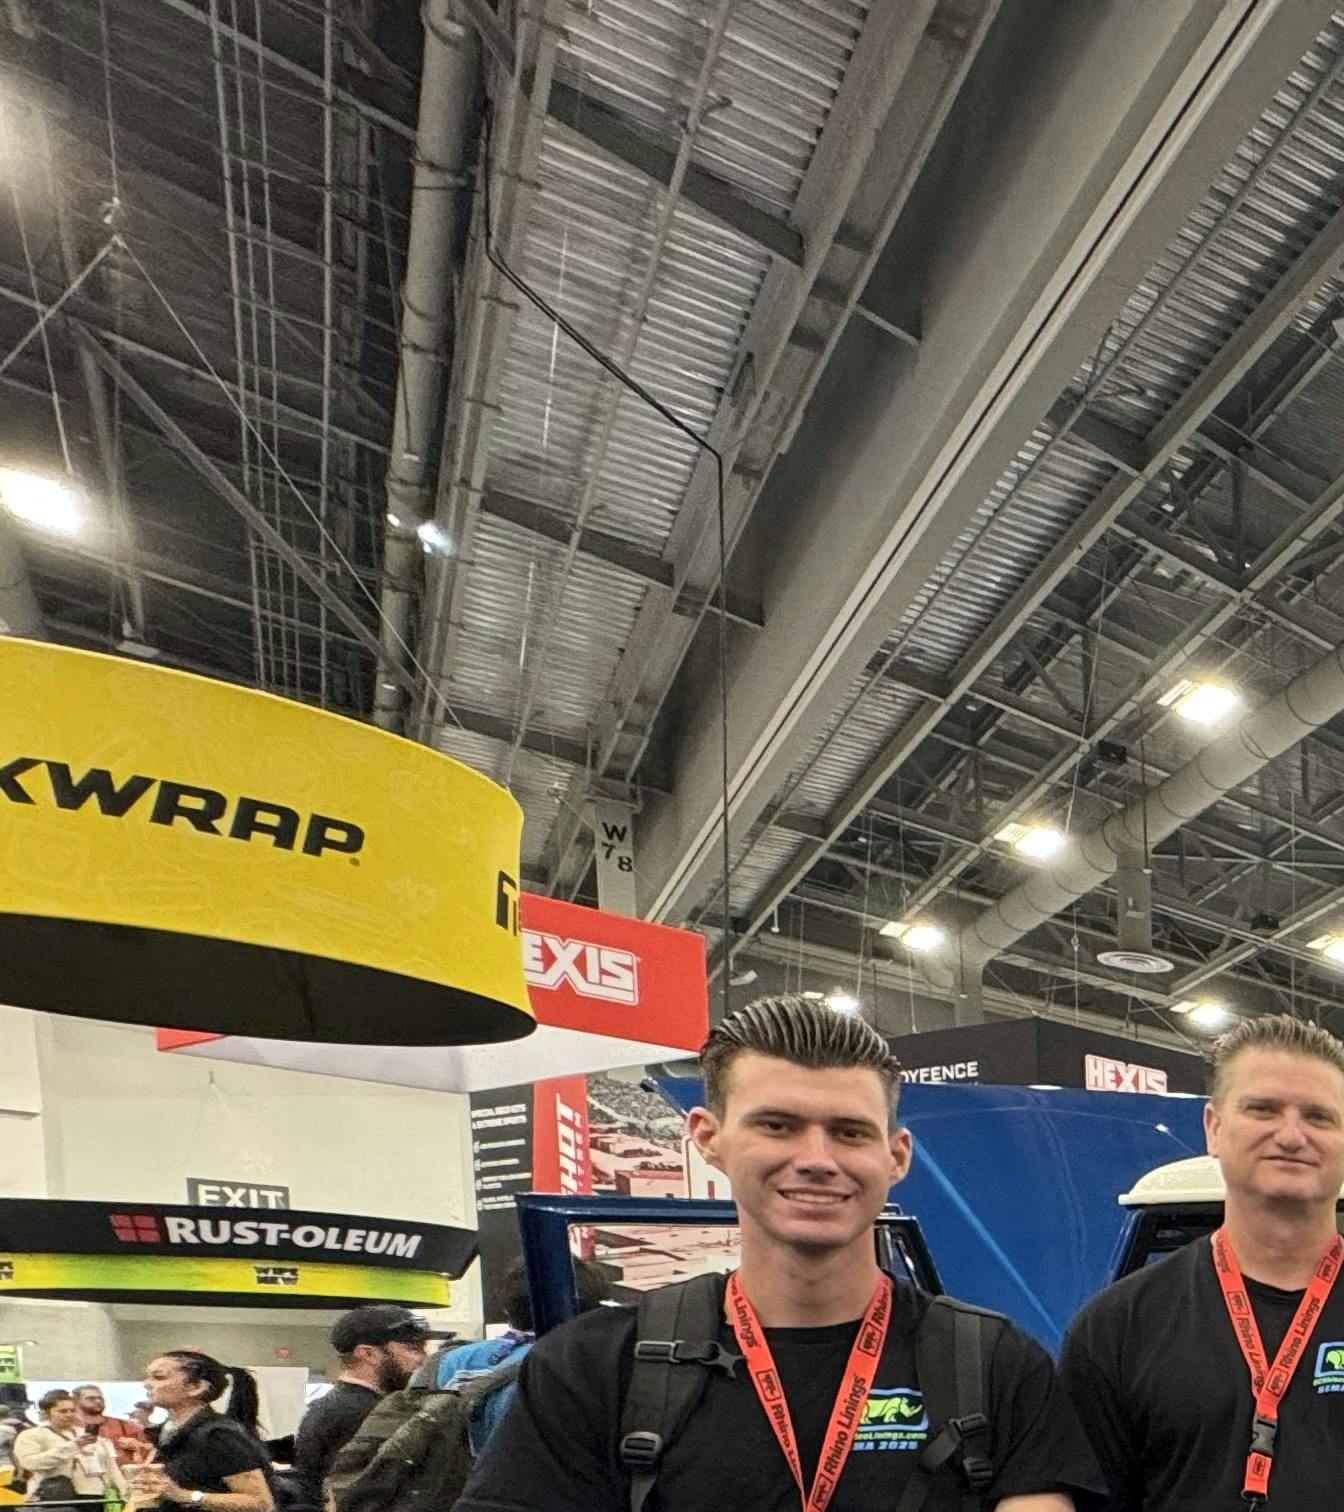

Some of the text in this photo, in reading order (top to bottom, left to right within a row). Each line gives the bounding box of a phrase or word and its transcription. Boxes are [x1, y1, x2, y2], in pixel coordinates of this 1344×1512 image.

[602, 822, 628, 842] W
[1086, 1055, 1167, 1093] HEXIS
[197, 1184, 284, 1209] EXIT
[163, 1215, 423, 1259] RUST-OLEUM
[733, 1296, 761, 1348] Linings
[1280, 1296, 1322, 1369] Rhino Linings
[824, 1375, 867, 1475] Rhino Linings
[877, 1440, 919, 1450] 2025
